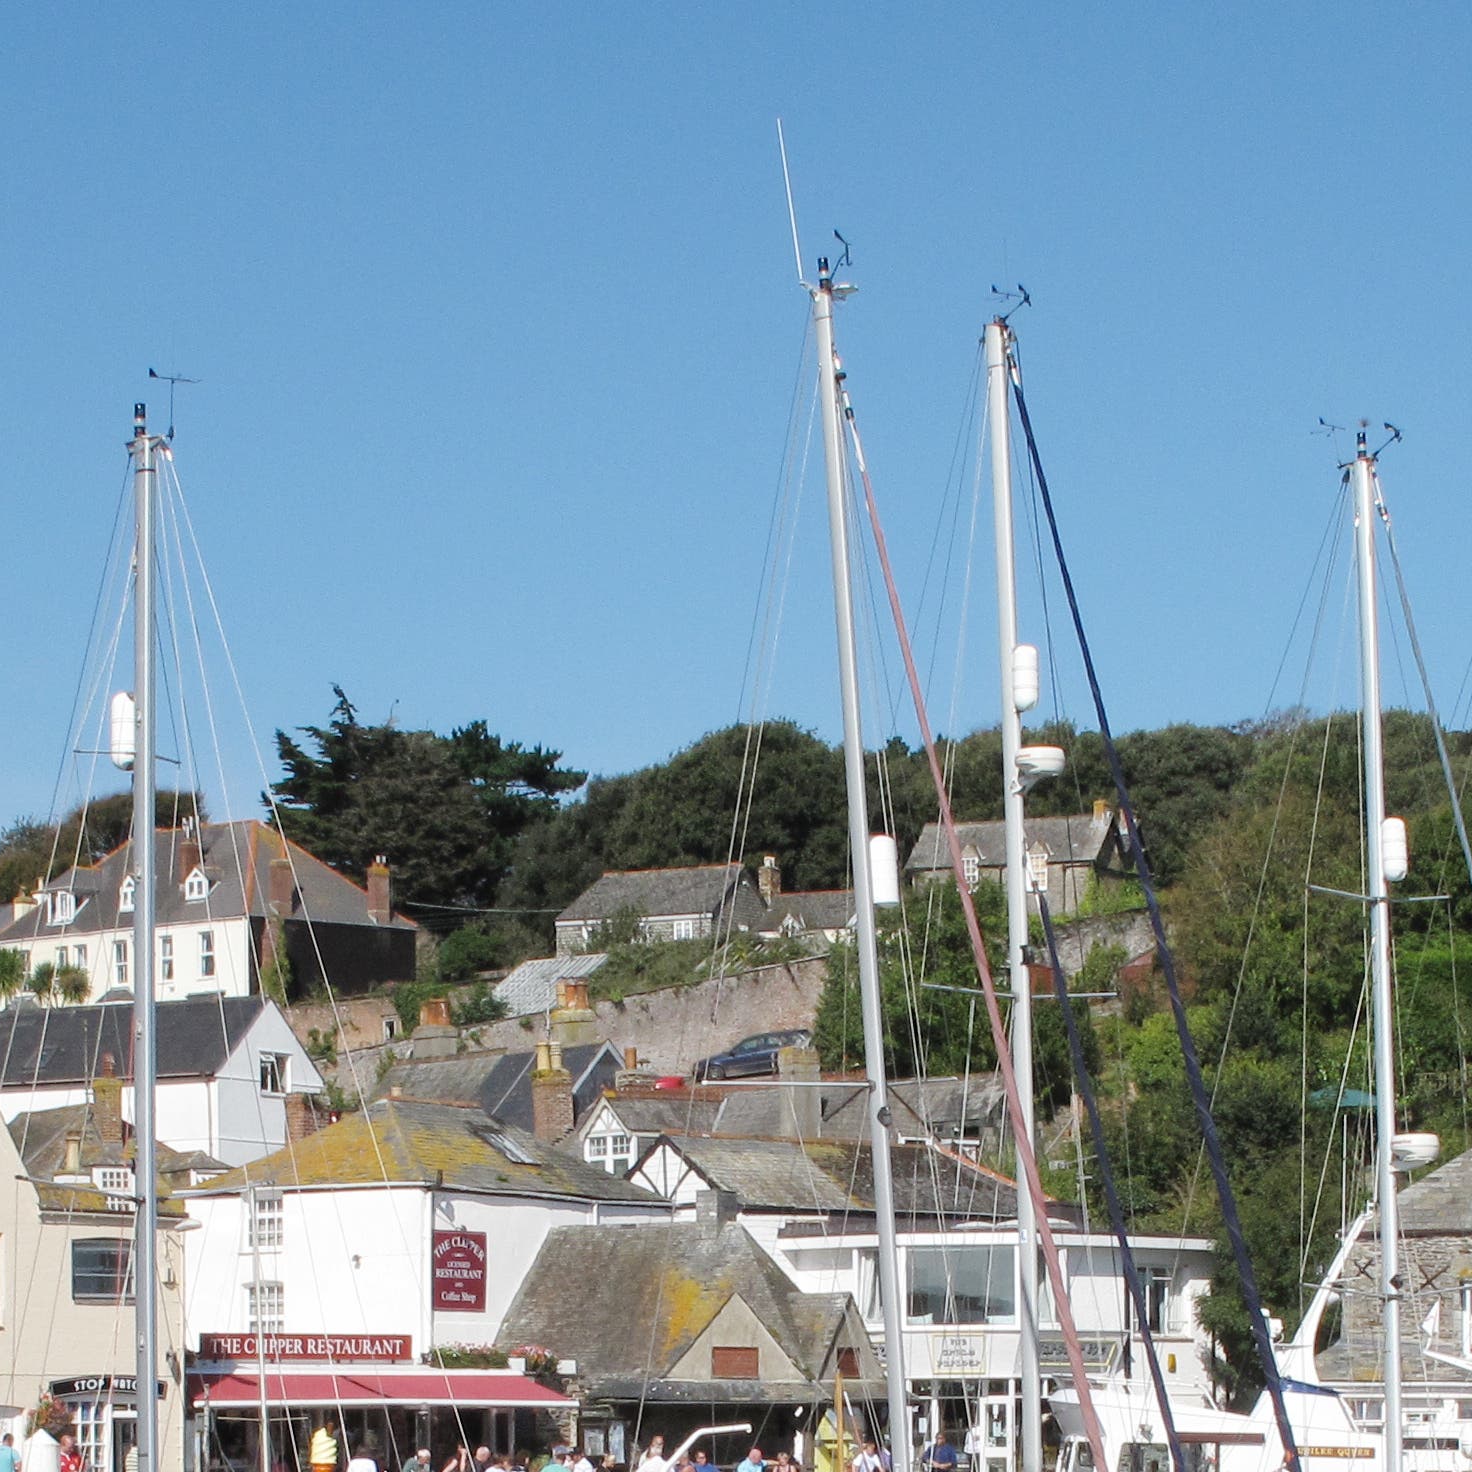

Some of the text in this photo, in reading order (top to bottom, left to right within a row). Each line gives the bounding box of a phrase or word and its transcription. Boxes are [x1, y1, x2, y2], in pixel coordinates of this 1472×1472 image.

[434, 1239, 451, 1258] THE
[435, 1268, 483, 1279] RESTAURANT
[212, 1338, 241, 1354] THE
[307, 1339, 404, 1355] RESTAURANT
[74, 1379, 105, 1392] STOP
